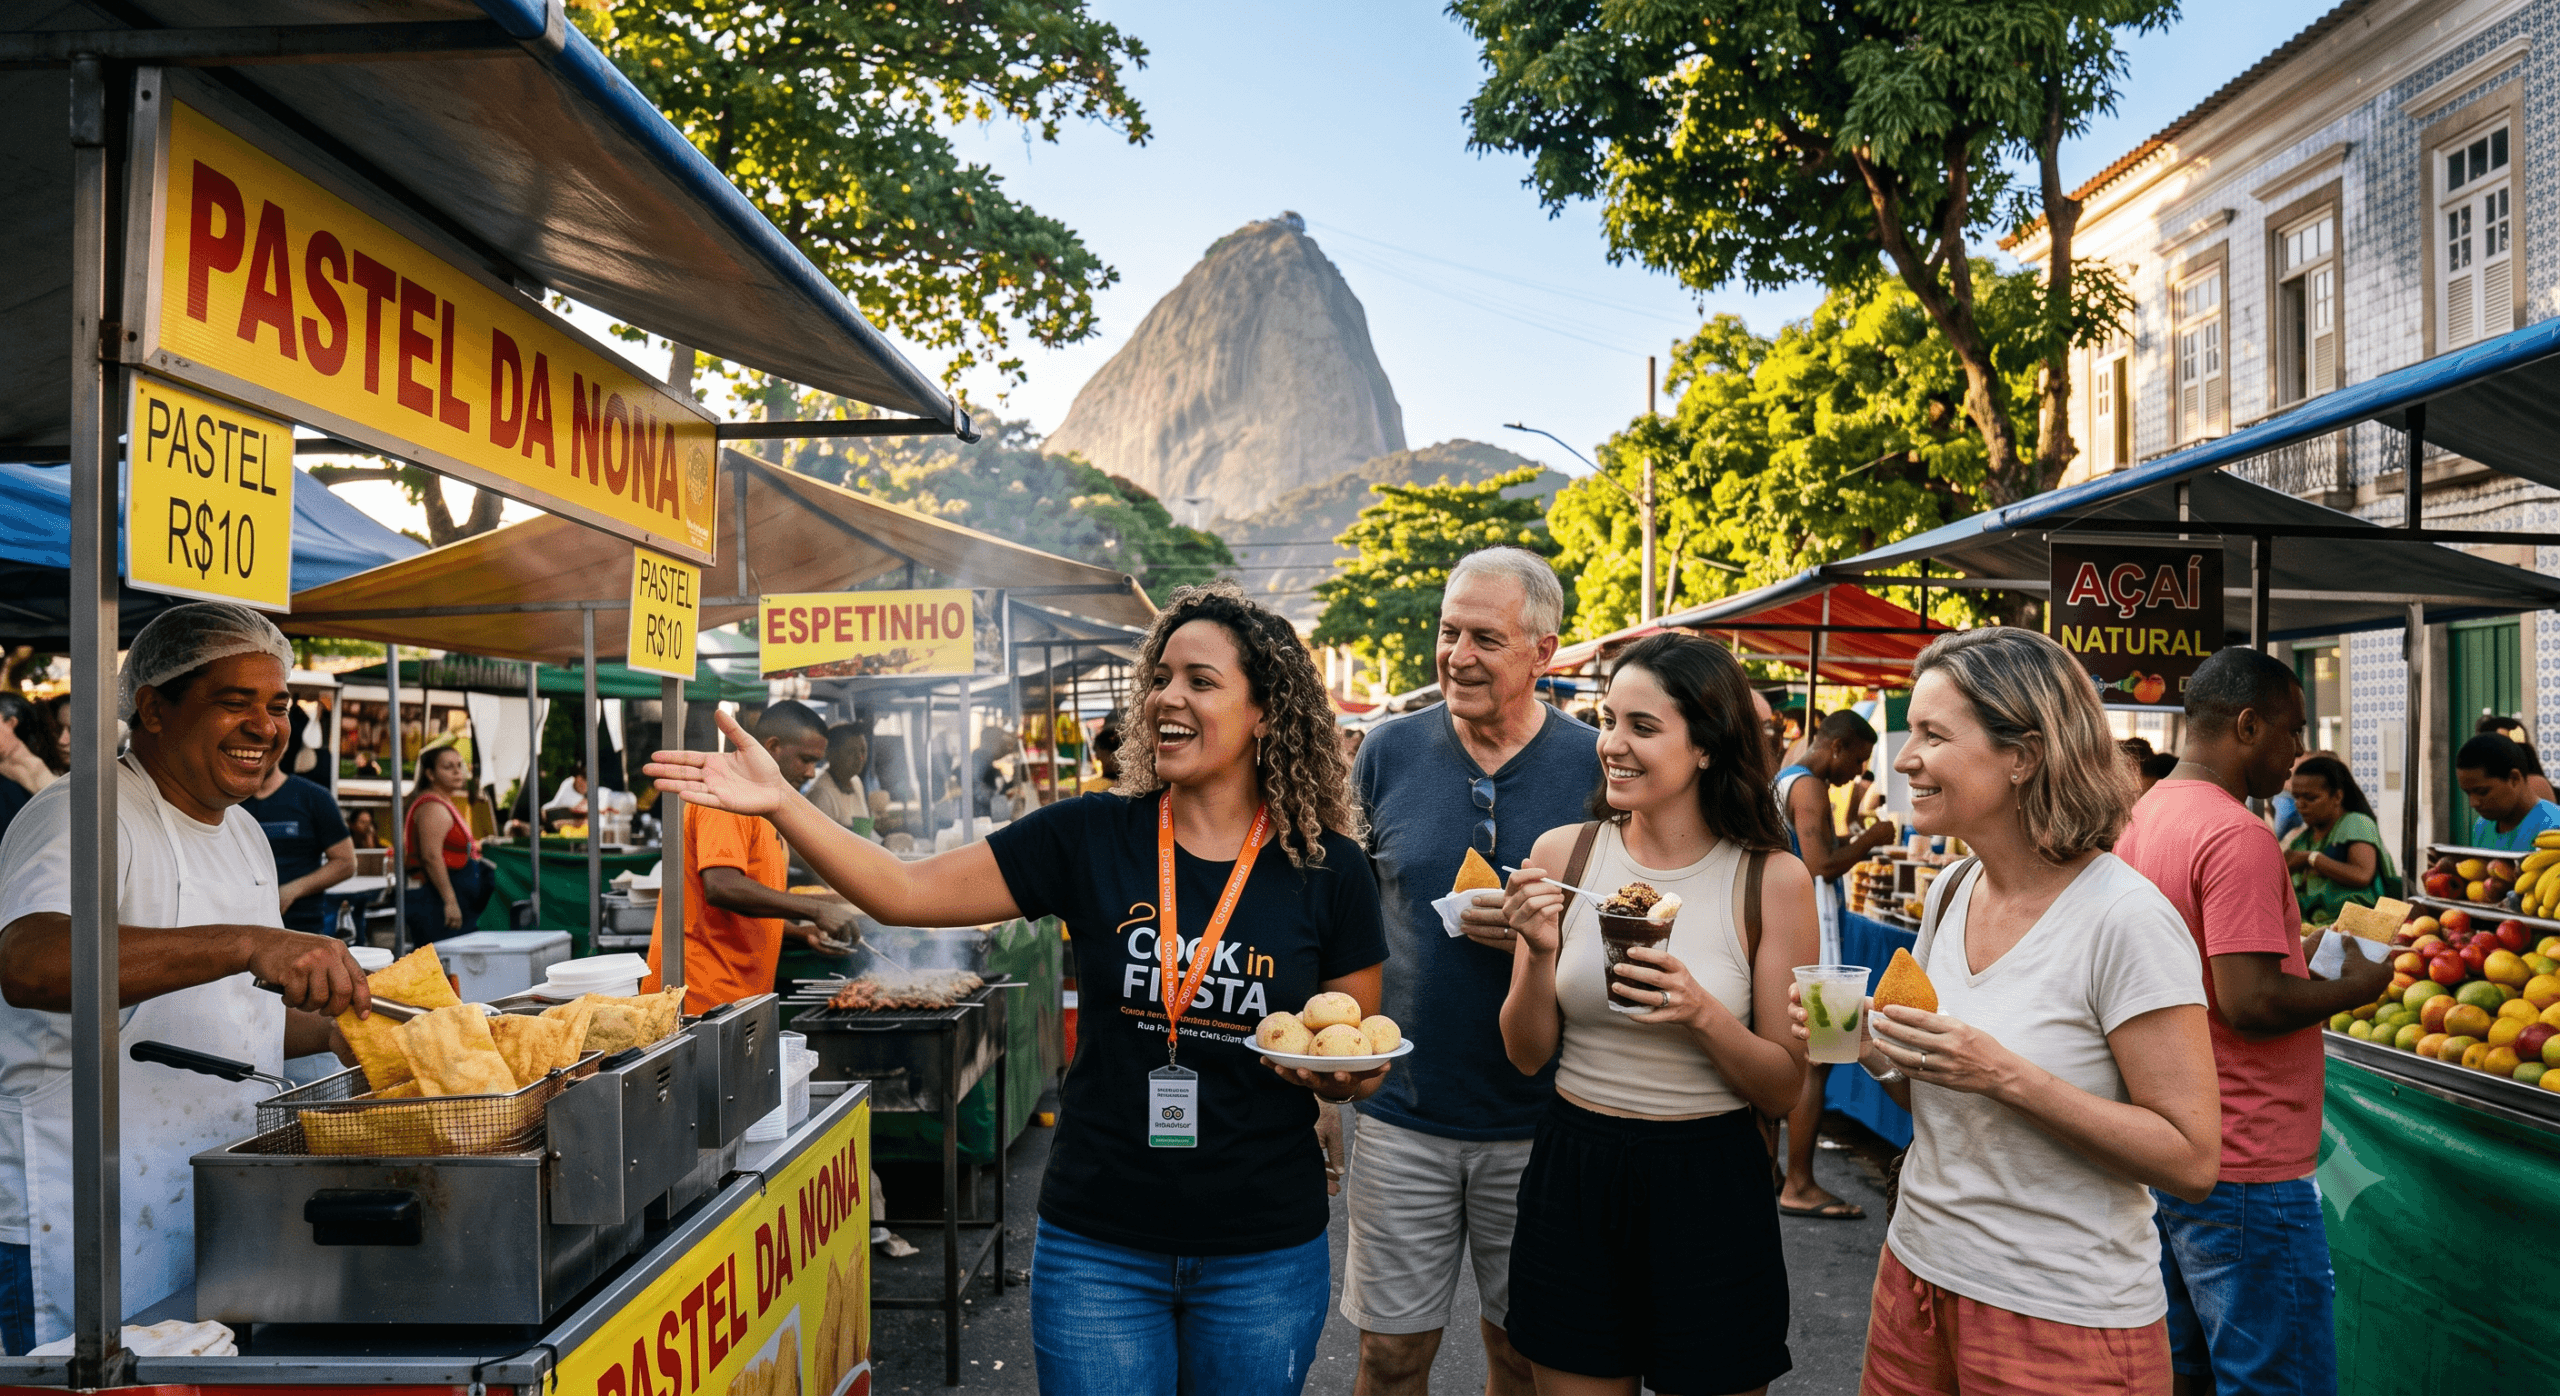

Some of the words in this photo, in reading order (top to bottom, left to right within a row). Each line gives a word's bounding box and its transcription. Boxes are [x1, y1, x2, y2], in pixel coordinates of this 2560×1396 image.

[187, 160, 470, 433] PASTEL
[490, 328, 555, 468] DA
[571, 373, 680, 520] NONA
[146, 398, 277, 497] PASTEL
[168, 496, 254, 580] R$10
[640, 557, 693, 610] PASTEL
[2067, 555, 2202, 619] AÇAÍ
[646, 614, 683, 662] R$10
[767, 602, 966, 645] ESPETINHO
[2061, 624, 2212, 657] NATURAL
[1247, 946, 1274, 978] in
[1123, 963, 1268, 1018] FISTA
[597, 1252, 748, 1396] ASTEL
[754, 1204, 793, 1320] DA
[798, 1137, 861, 1270] NONA
